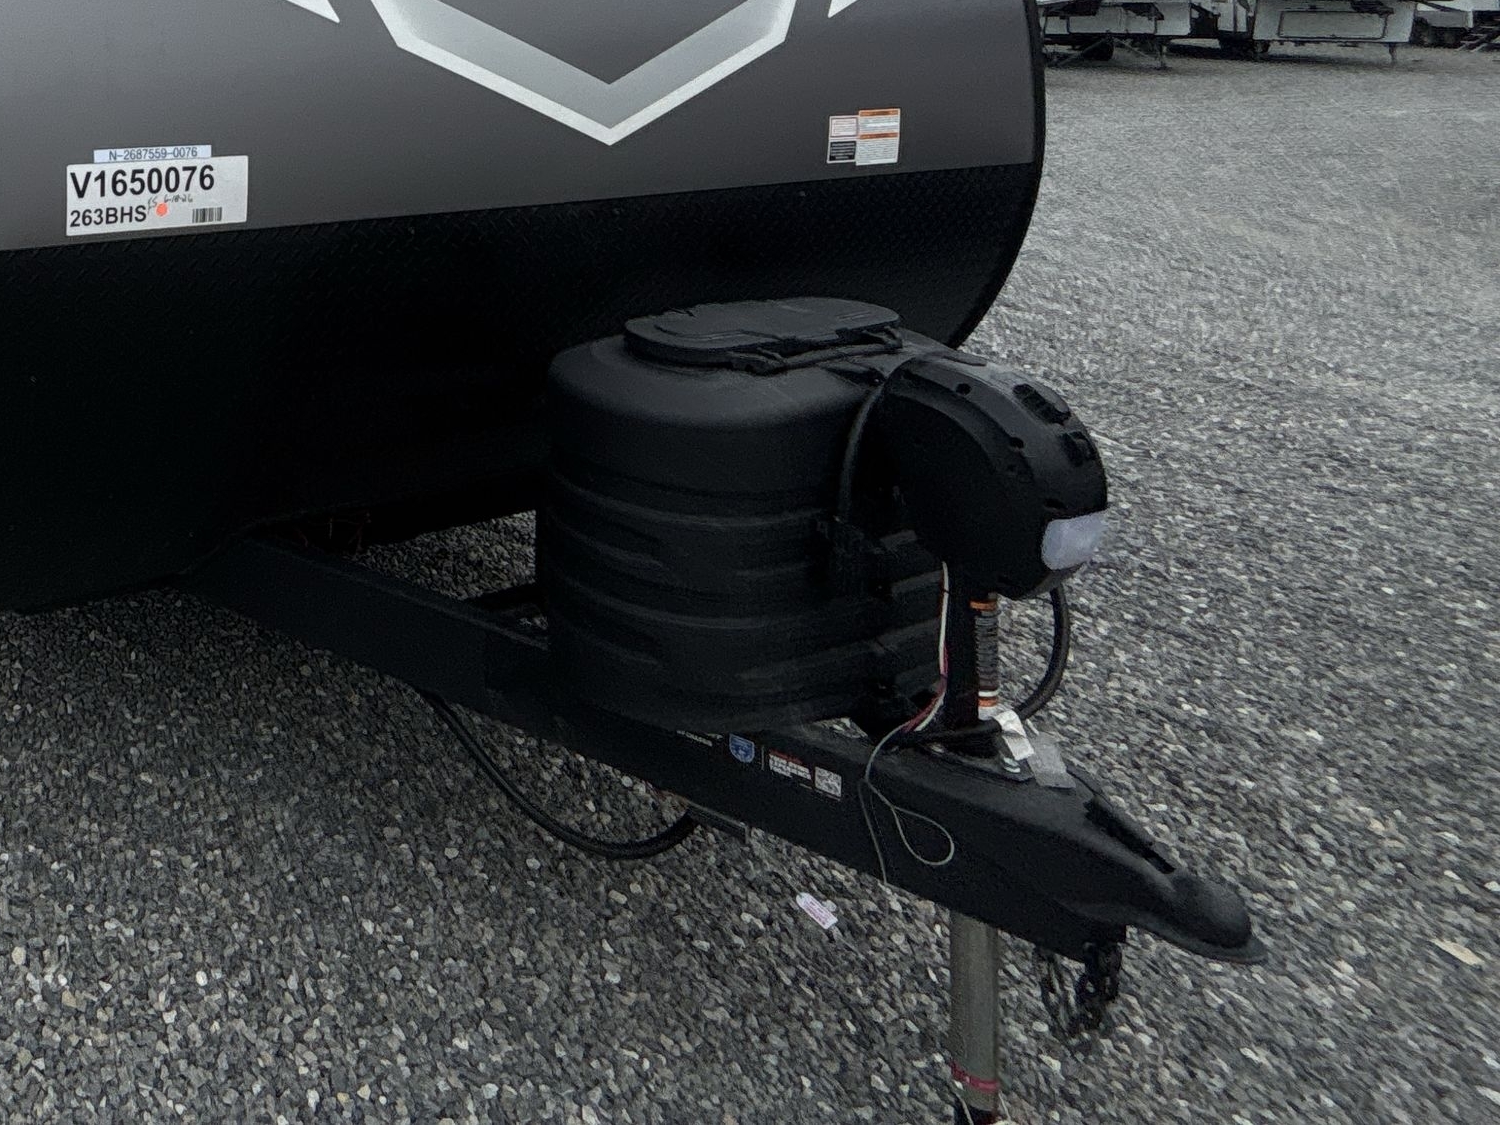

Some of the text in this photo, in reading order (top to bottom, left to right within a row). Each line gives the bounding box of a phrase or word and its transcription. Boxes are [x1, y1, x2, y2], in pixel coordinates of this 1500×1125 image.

[108, 147, 198, 161] N-2687559-0076
[70, 165, 215, 199] V1650076
[70, 205, 147, 227] 263BHS
